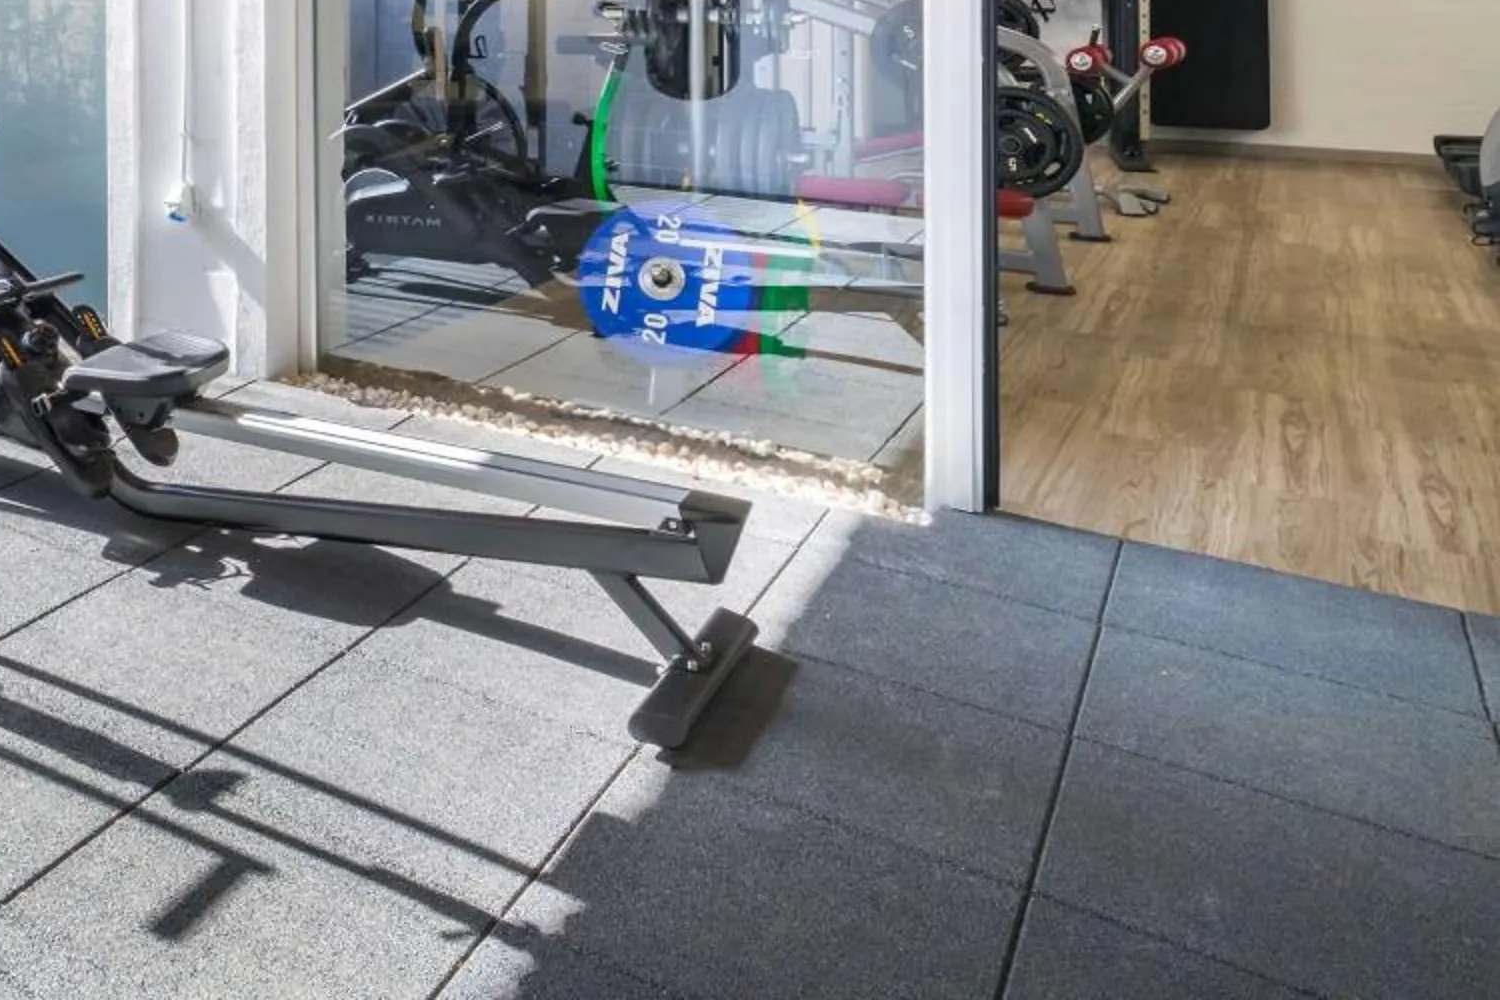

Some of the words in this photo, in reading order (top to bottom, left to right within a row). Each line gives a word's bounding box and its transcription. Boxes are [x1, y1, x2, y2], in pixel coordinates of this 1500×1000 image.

[654, 214, 681, 245] 20
[602, 232, 629, 315] ZIVA
[696, 247, 723, 327] ZIVA
[642, 313, 669, 345] 20
